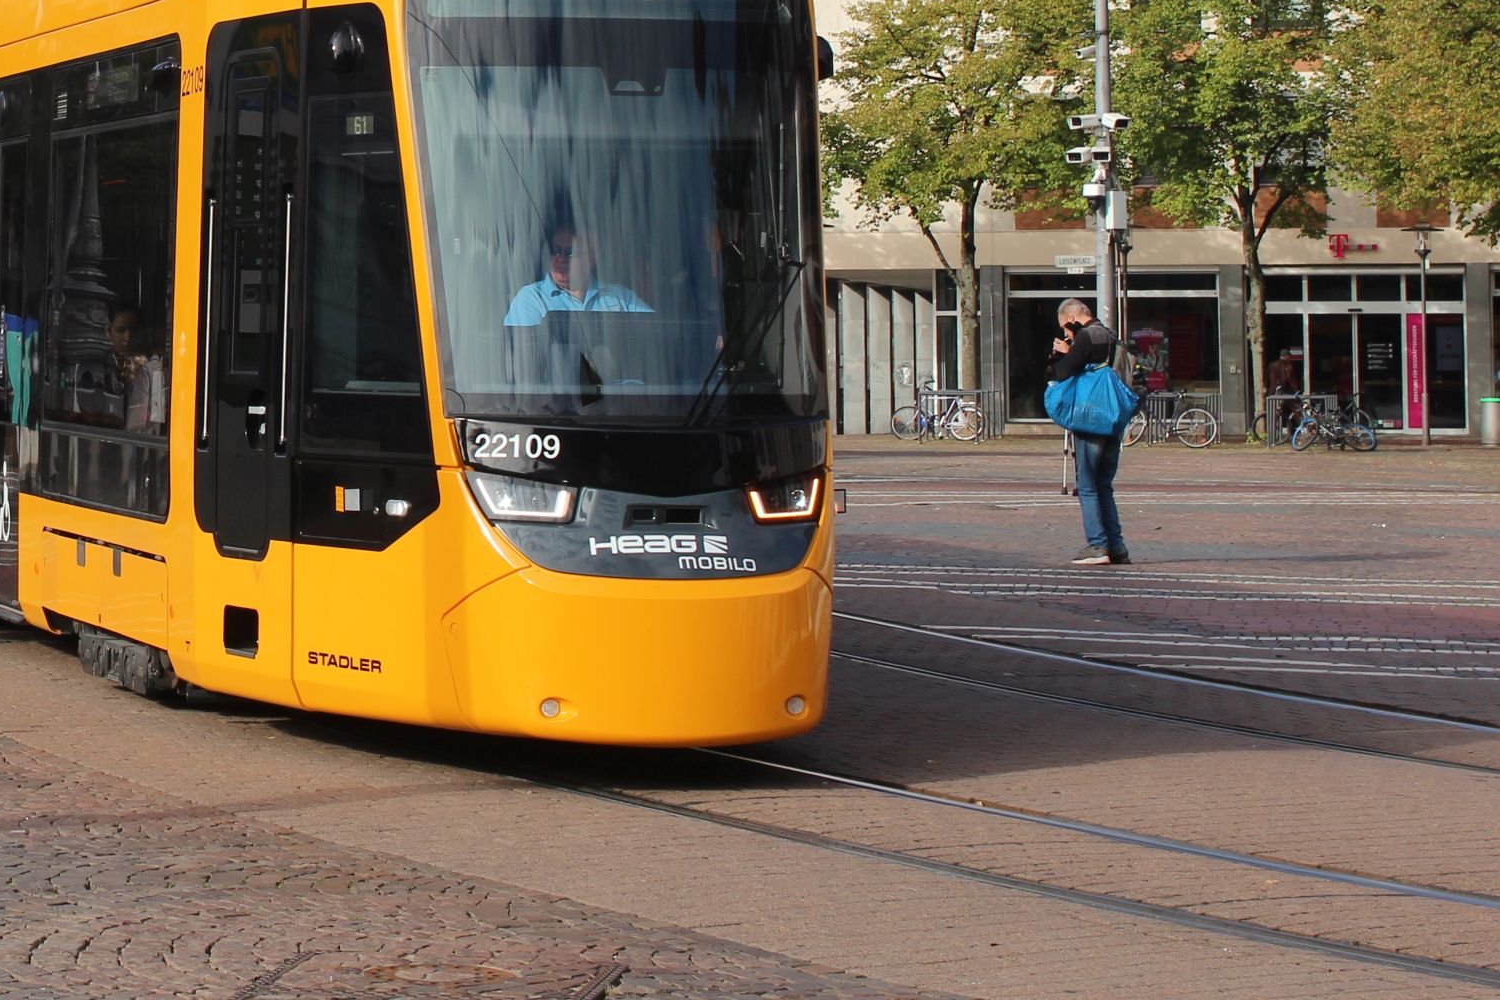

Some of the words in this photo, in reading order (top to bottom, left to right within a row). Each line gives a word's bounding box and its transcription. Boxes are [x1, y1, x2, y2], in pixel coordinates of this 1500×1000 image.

[181, 64, 204, 97] 22109
[354, 116, 367, 135] 61
[473, 433, 561, 459] 22109
[307, 651, 383, 674] STADLER
